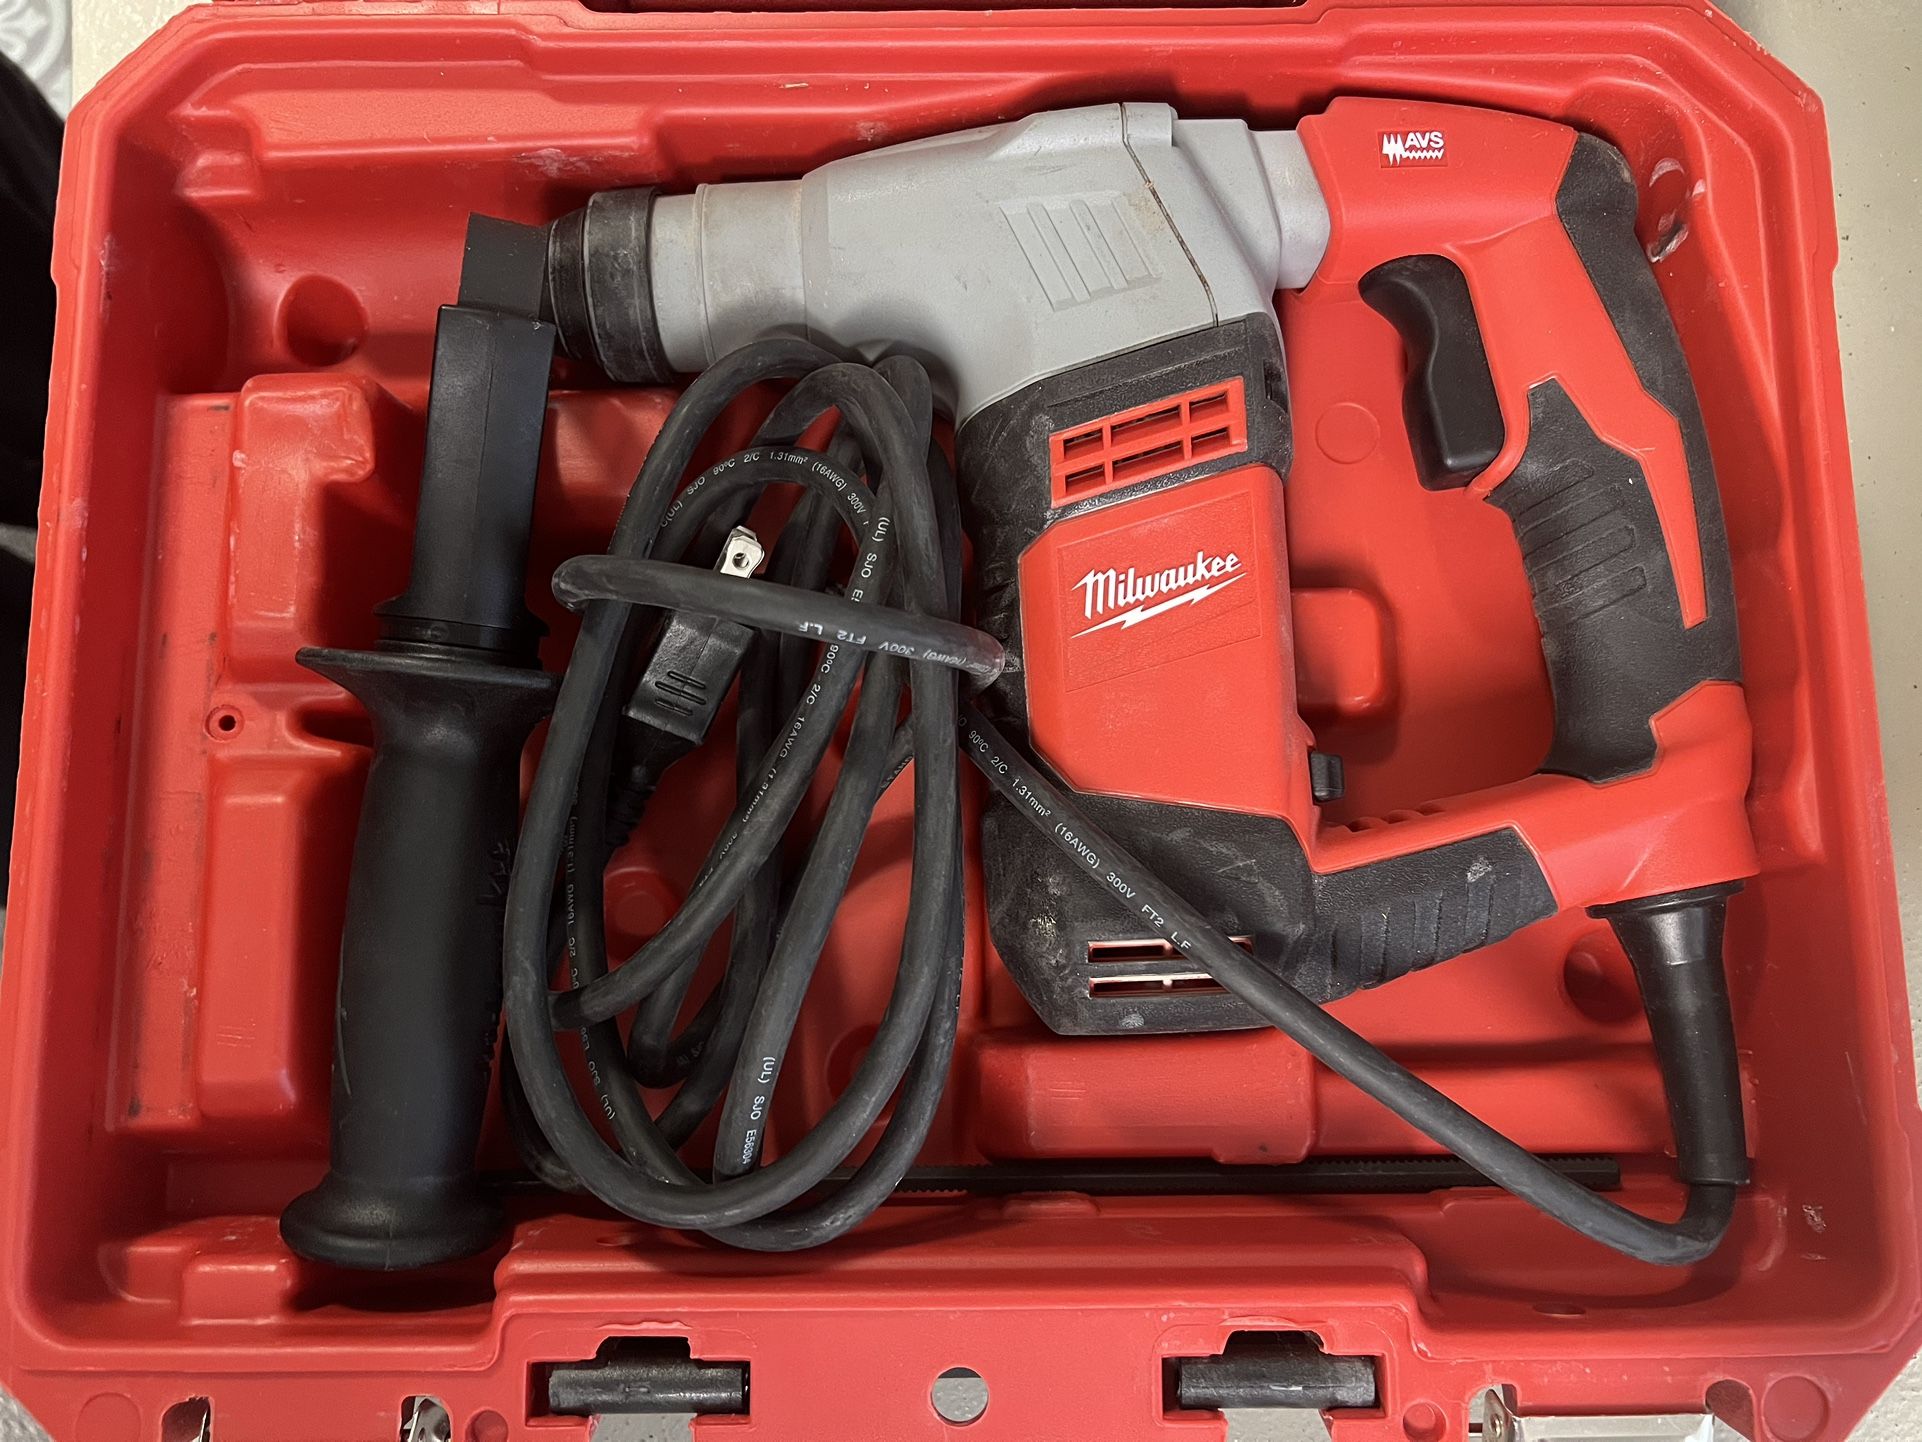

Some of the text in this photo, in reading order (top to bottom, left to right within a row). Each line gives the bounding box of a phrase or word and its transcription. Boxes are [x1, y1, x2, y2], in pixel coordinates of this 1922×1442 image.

[1405, 131, 1444, 149] AVS
[687, 476, 706, 495] SJO
[743, 451, 760, 463] 2/C
[812, 461, 847, 492] (16AWG)
[847, 492, 868, 514] 300V
[872, 517, 891, 542] (UL)
[861, 552, 878, 578] SJO
[1070, 550, 1242, 620] Milwaukee
[836, 629, 867, 645] FT2
[878, 641, 916, 655] 300V
[806, 684, 821, 705] 2/C
[779, 716, 806, 758] 16AWG
[990, 756, 1008, 774] 2/C
[1054, 822, 1101, 869] (16AWG)
[1106, 872, 1136, 899] 300V
[1141, 903, 1165, 928] FT2
[757, 1056, 776, 1084] (UL)
[750, 1095, 765, 1121] SJO
